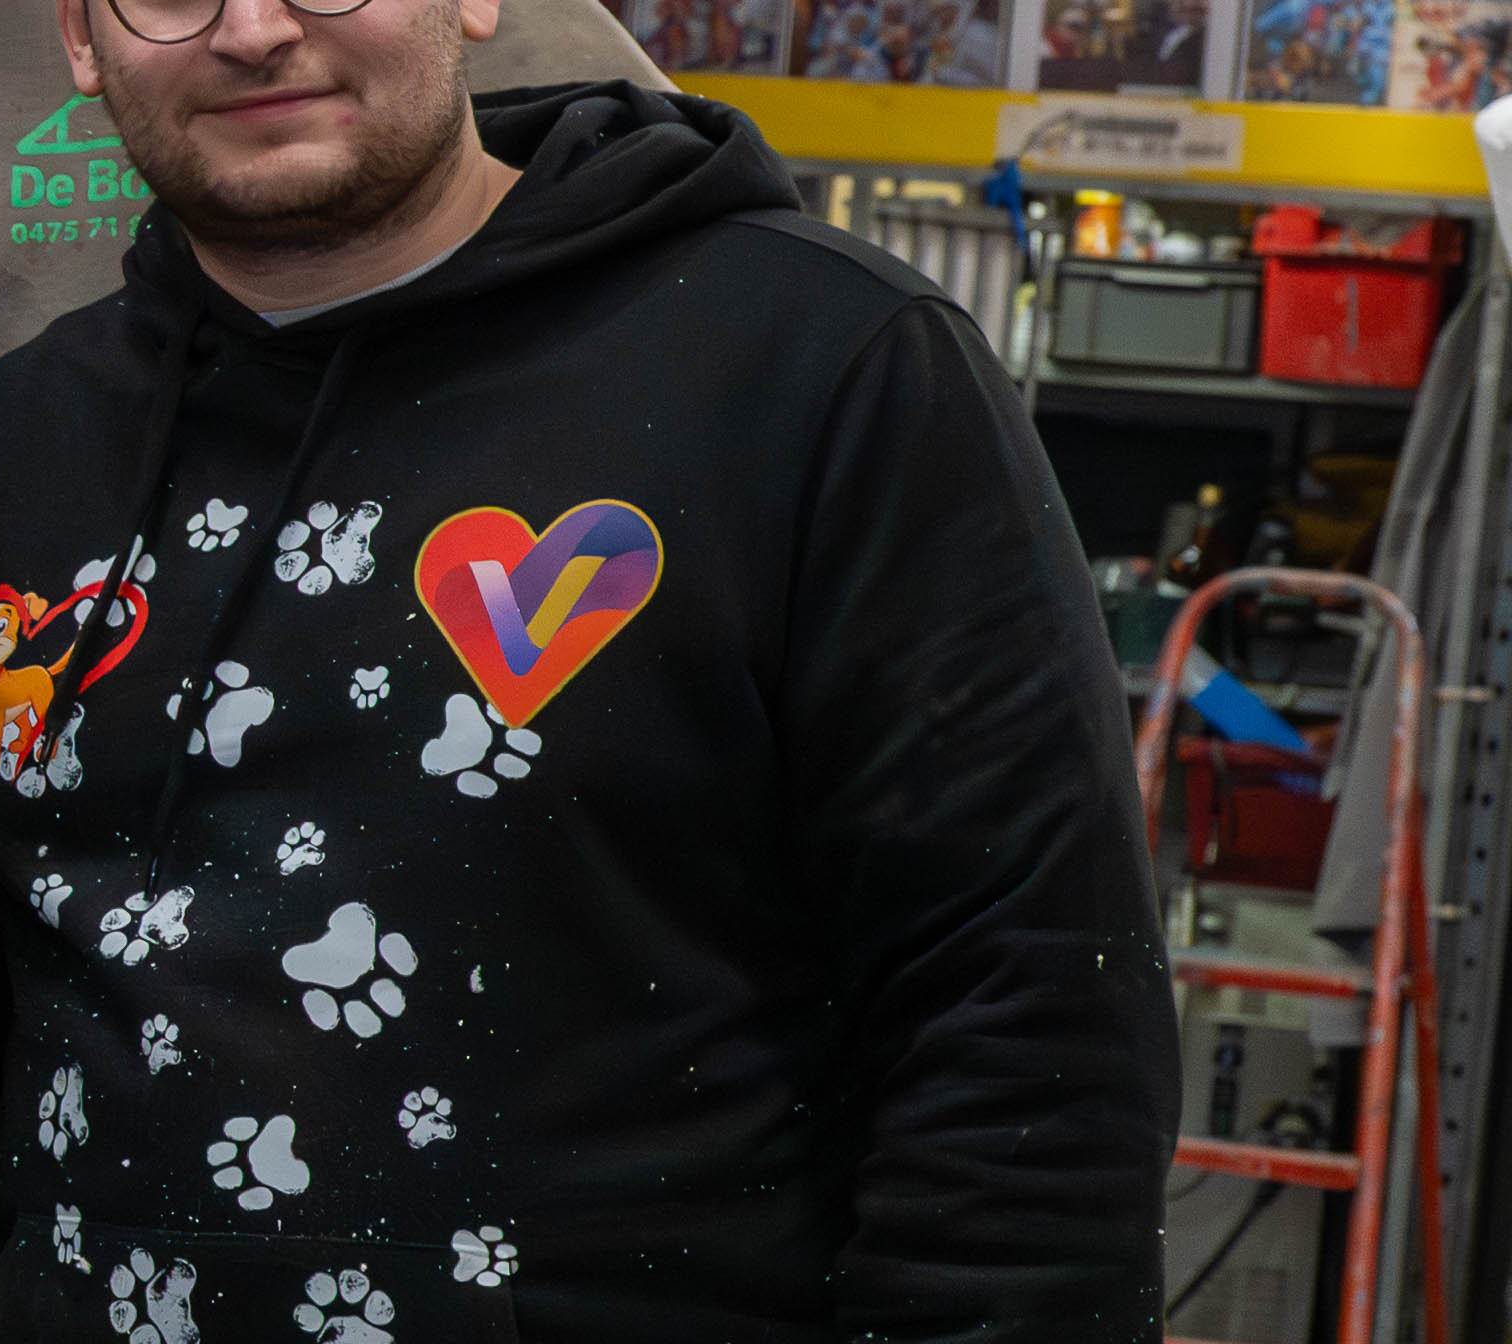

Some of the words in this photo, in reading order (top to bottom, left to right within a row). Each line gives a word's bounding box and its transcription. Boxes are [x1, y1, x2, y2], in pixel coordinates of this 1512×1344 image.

[10, 164, 75, 208] De
[87, 158, 151, 202] Bo
[10, 219, 78, 244] 0475
